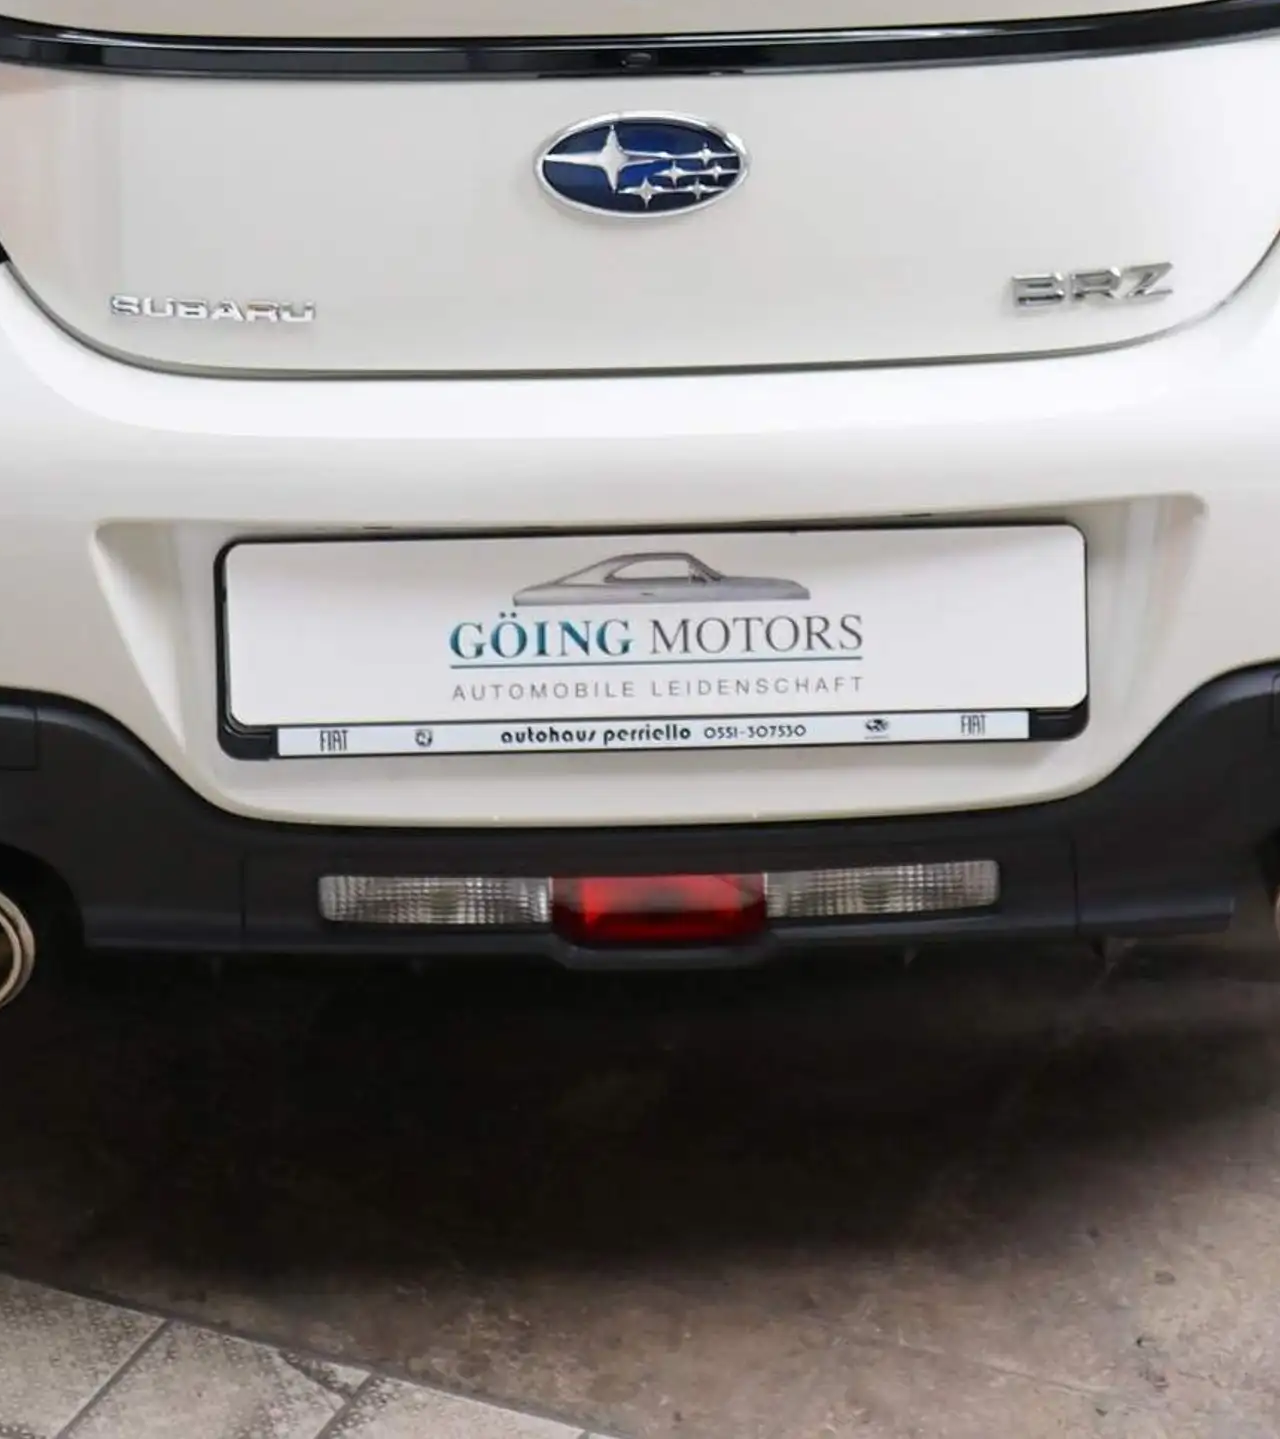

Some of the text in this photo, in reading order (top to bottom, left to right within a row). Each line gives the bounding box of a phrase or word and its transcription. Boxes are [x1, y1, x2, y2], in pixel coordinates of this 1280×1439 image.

[109, 294, 317, 324] SUBARU
[449, 611, 864, 659] GÖING MOTORS
[452, 675, 864, 702] AUTOMOBILE LEIDENSCHAFT
[500, 722, 808, 747] autohaus perriello 0551-307530
[960, 713, 986, 736] FIAT
[320, 729, 349, 752] FIAT
